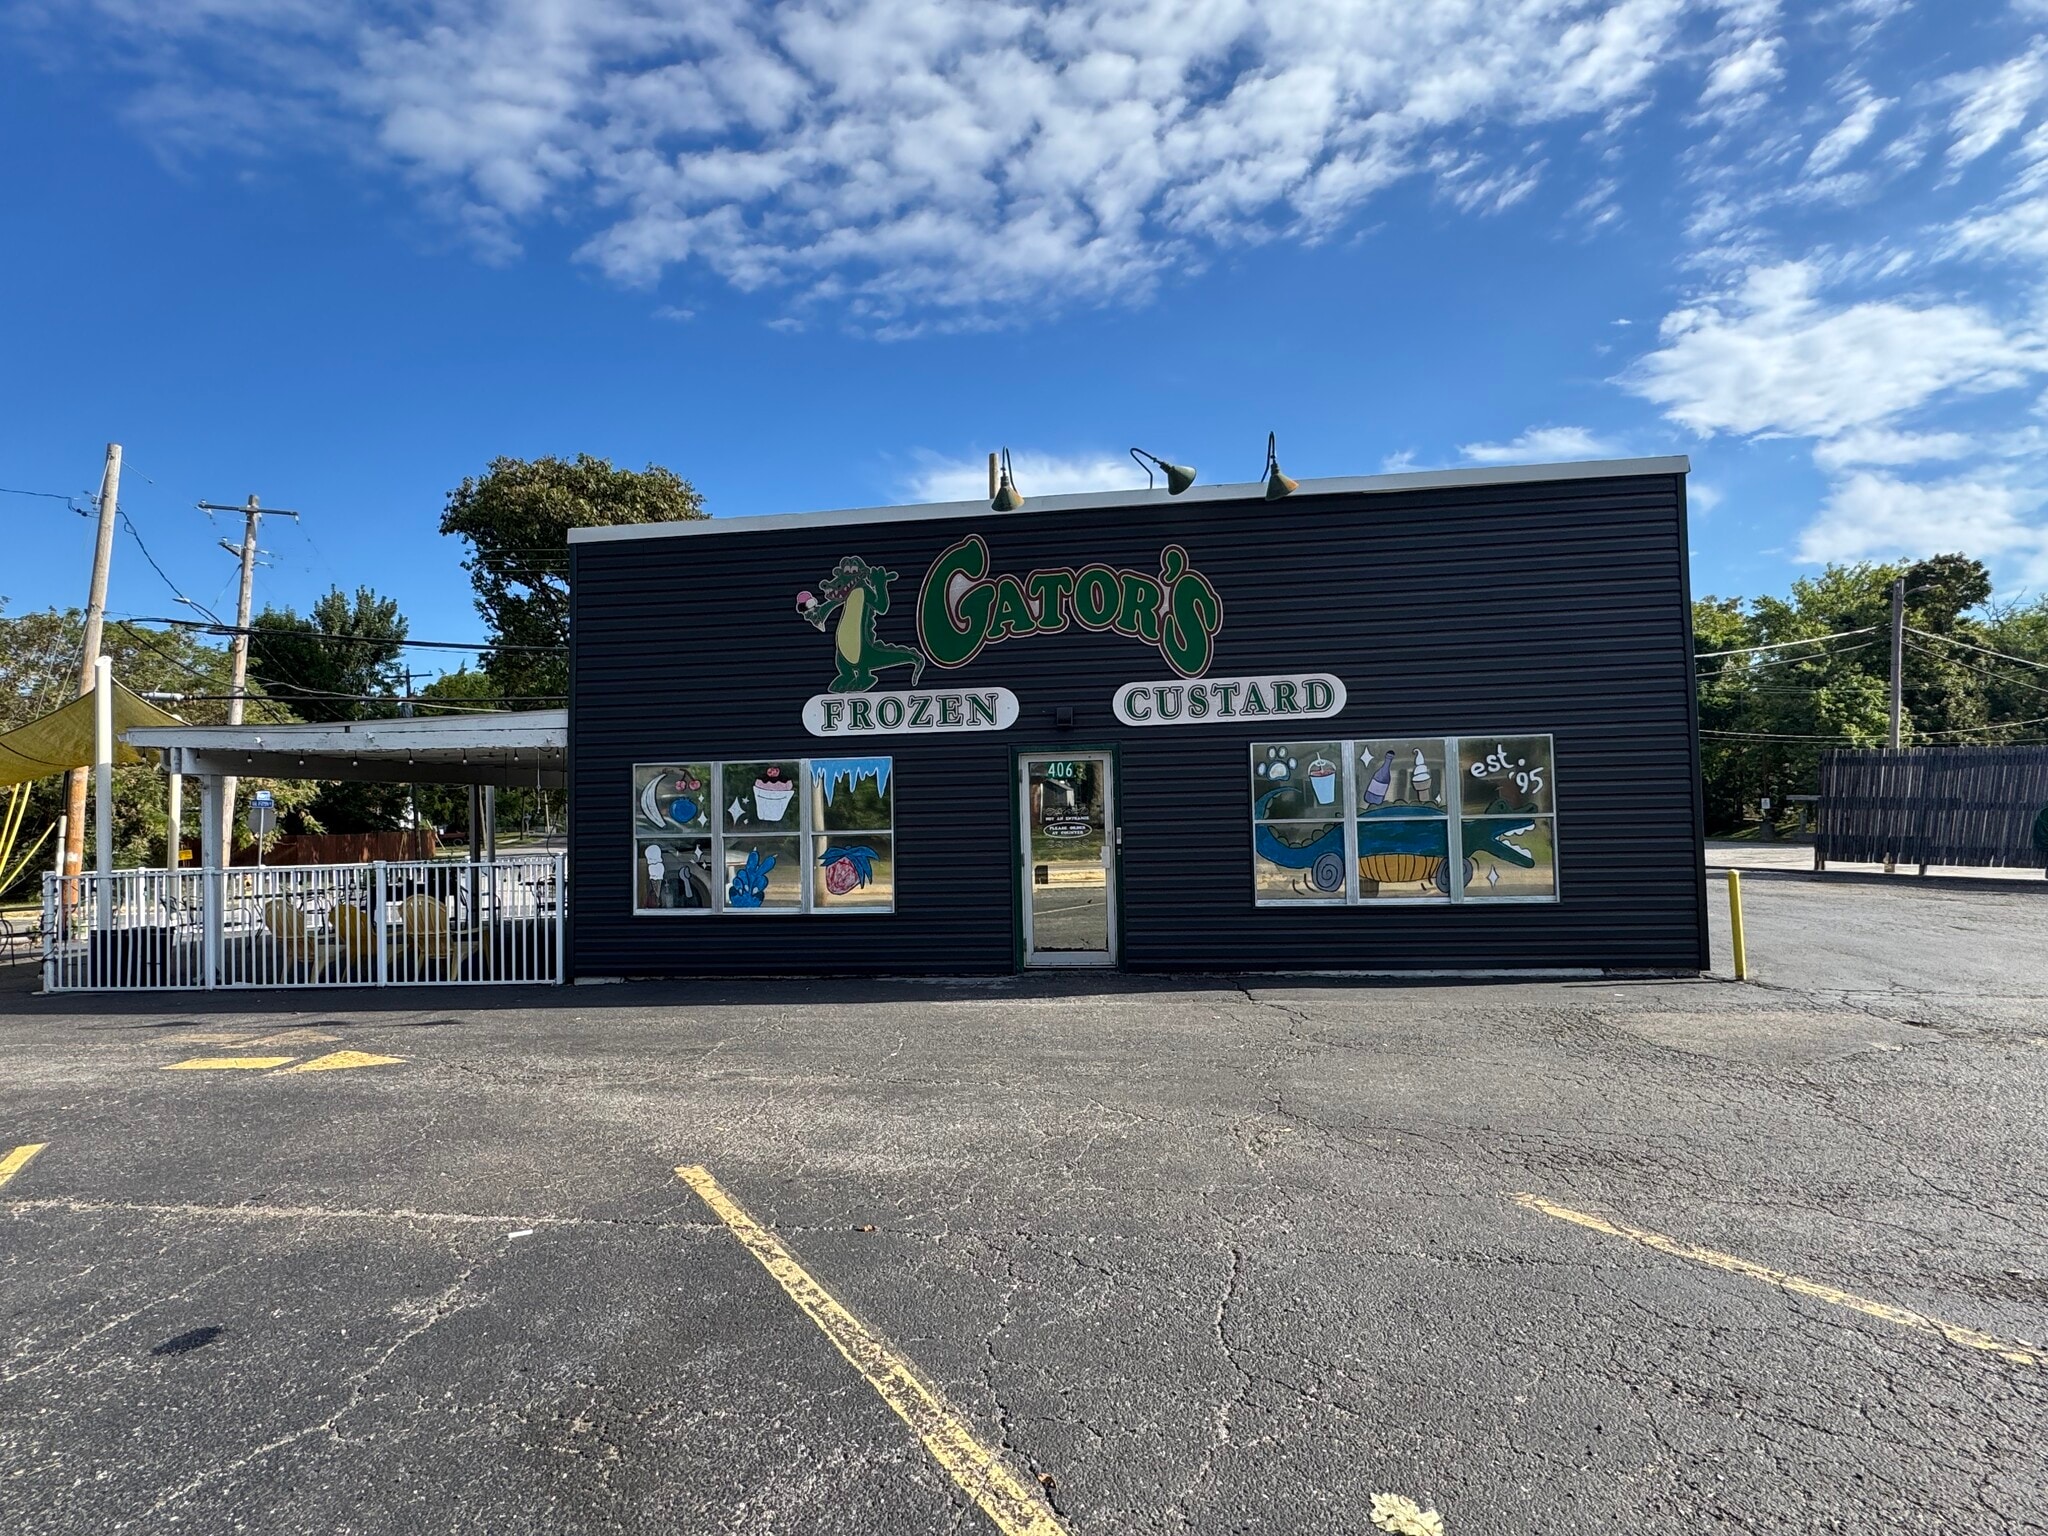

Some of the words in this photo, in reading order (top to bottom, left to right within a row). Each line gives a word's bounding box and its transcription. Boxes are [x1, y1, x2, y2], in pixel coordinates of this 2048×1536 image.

[917, 534, 1223, 678] GATOR'S
[821, 692, 999, 732] FROZEN
[1124, 679, 1336, 720] CUSTARD
[1047, 762, 1073, 777] 406
[1470, 744, 1525, 777] est.
[1508, 767, 1544, 794] '95
